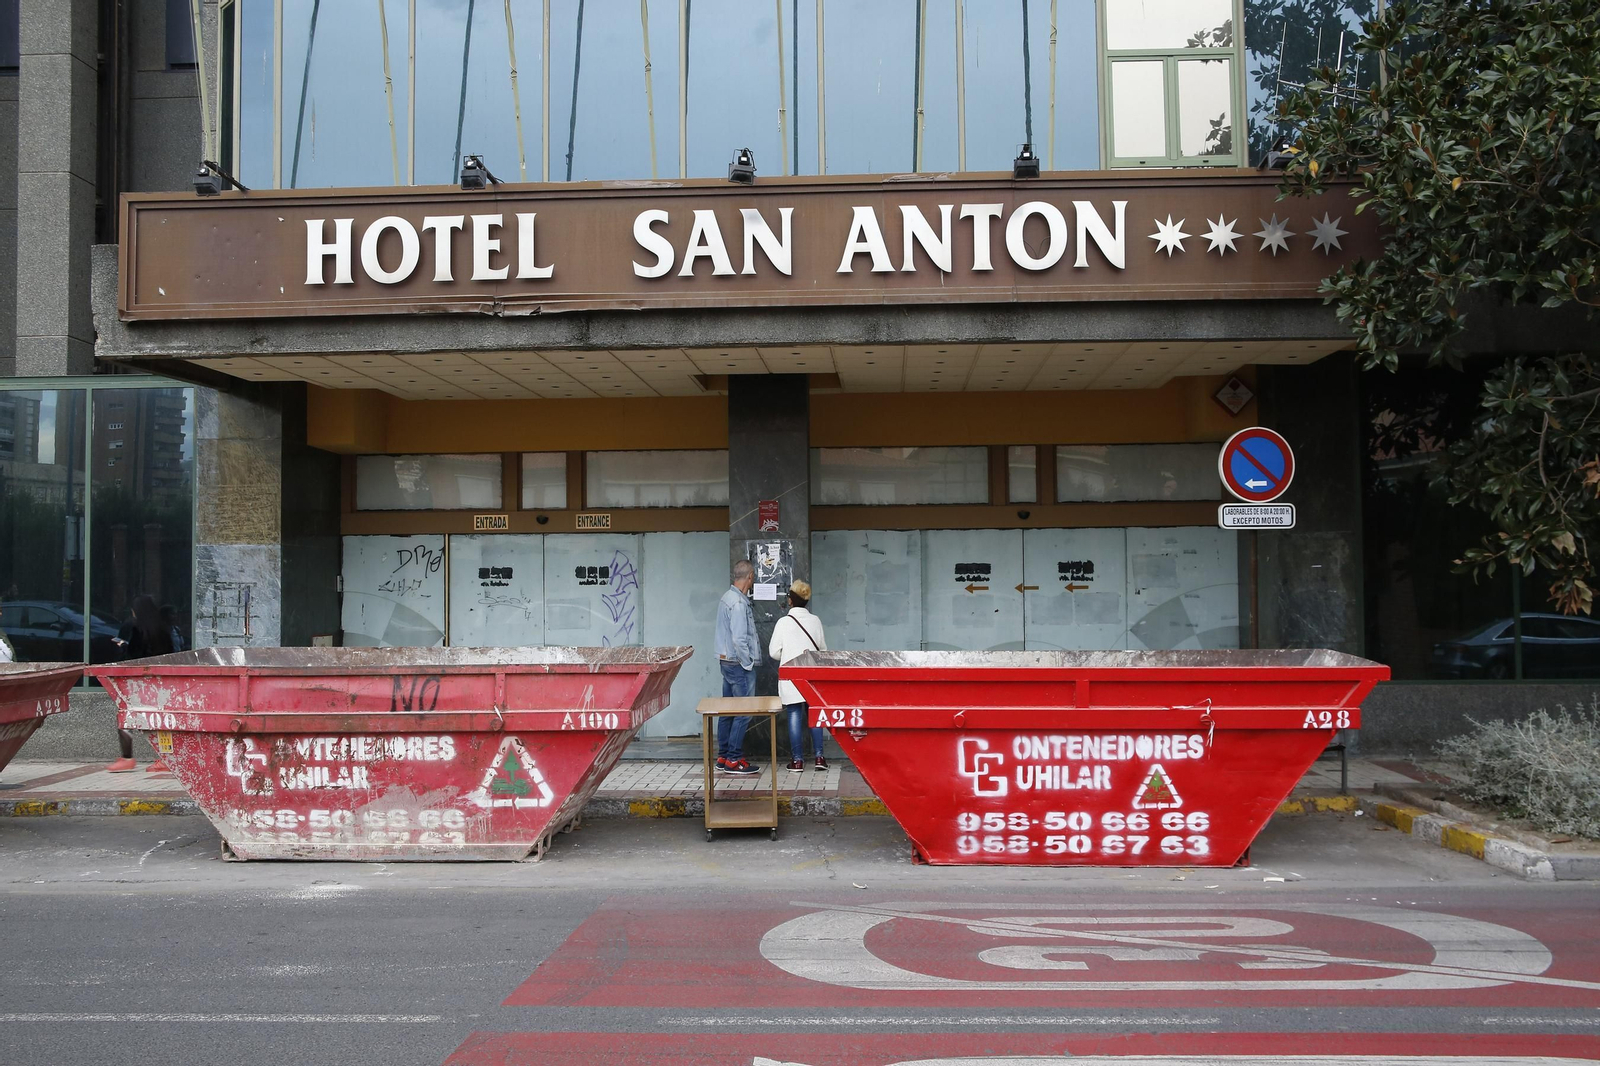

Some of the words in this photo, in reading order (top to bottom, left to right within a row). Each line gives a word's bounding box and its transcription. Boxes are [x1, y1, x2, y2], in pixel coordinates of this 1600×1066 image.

[304, 212, 555, 285] HOTEL
[632, 207, 795, 279] SAN
[836, 200, 1129, 273] ANTON
[577, 515, 610, 528] ENTRANCE
[1225, 508, 1252, 516] LABORABLES
[1232, 517, 1260, 525] EXCEPTO
[1261, 517, 1284, 525] MOTOS
[475, 516, 507, 529] ENTRADA
[390, 674, 441, 713] NO
[35, 698, 61, 717] A22
[561, 711, 619, 730] A100
[816, 708, 864, 728] A28
[1303, 709, 1350, 729] A28
[1013, 734, 1205, 761] ONTENEDORES
[1016, 765, 1112, 790] UHILAR
[418, 808, 466, 829] 66
[1101, 811, 1151, 832] 66
[1161, 811, 1210, 832] 66
[1101, 835, 1151, 856] 67
[1161, 835, 1210, 856] 63
